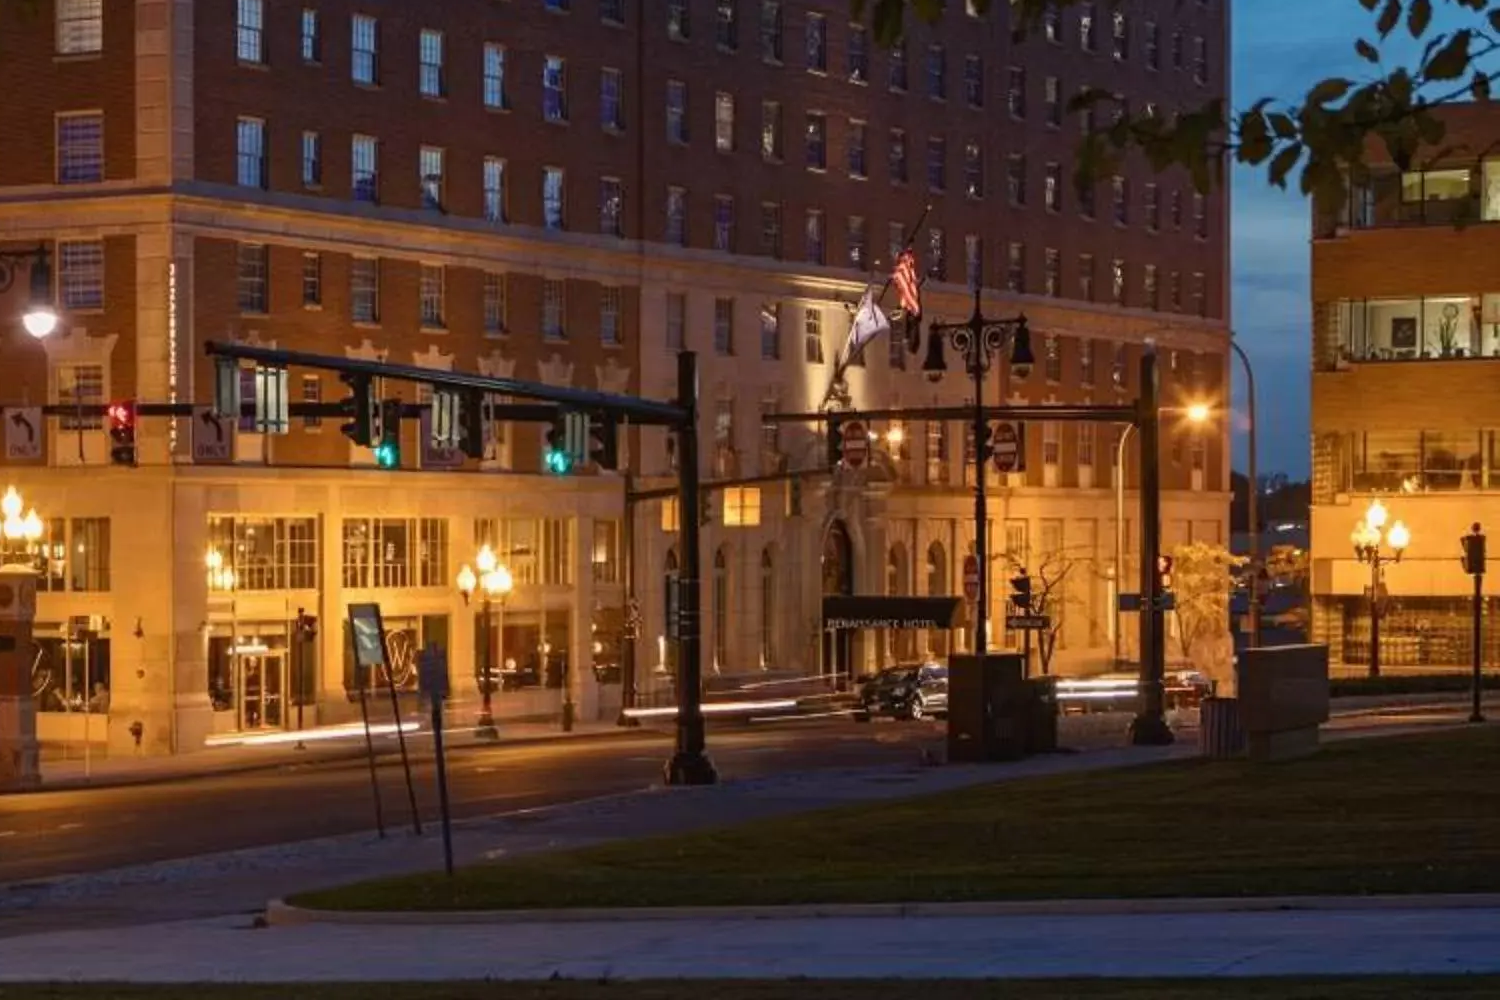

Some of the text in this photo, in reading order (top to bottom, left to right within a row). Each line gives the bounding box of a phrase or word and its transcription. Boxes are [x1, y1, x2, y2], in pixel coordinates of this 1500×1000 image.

[169, 391, 177, 452] HTEL
[10, 444, 38, 457] ONLY
[197, 444, 228, 457] ONLY
